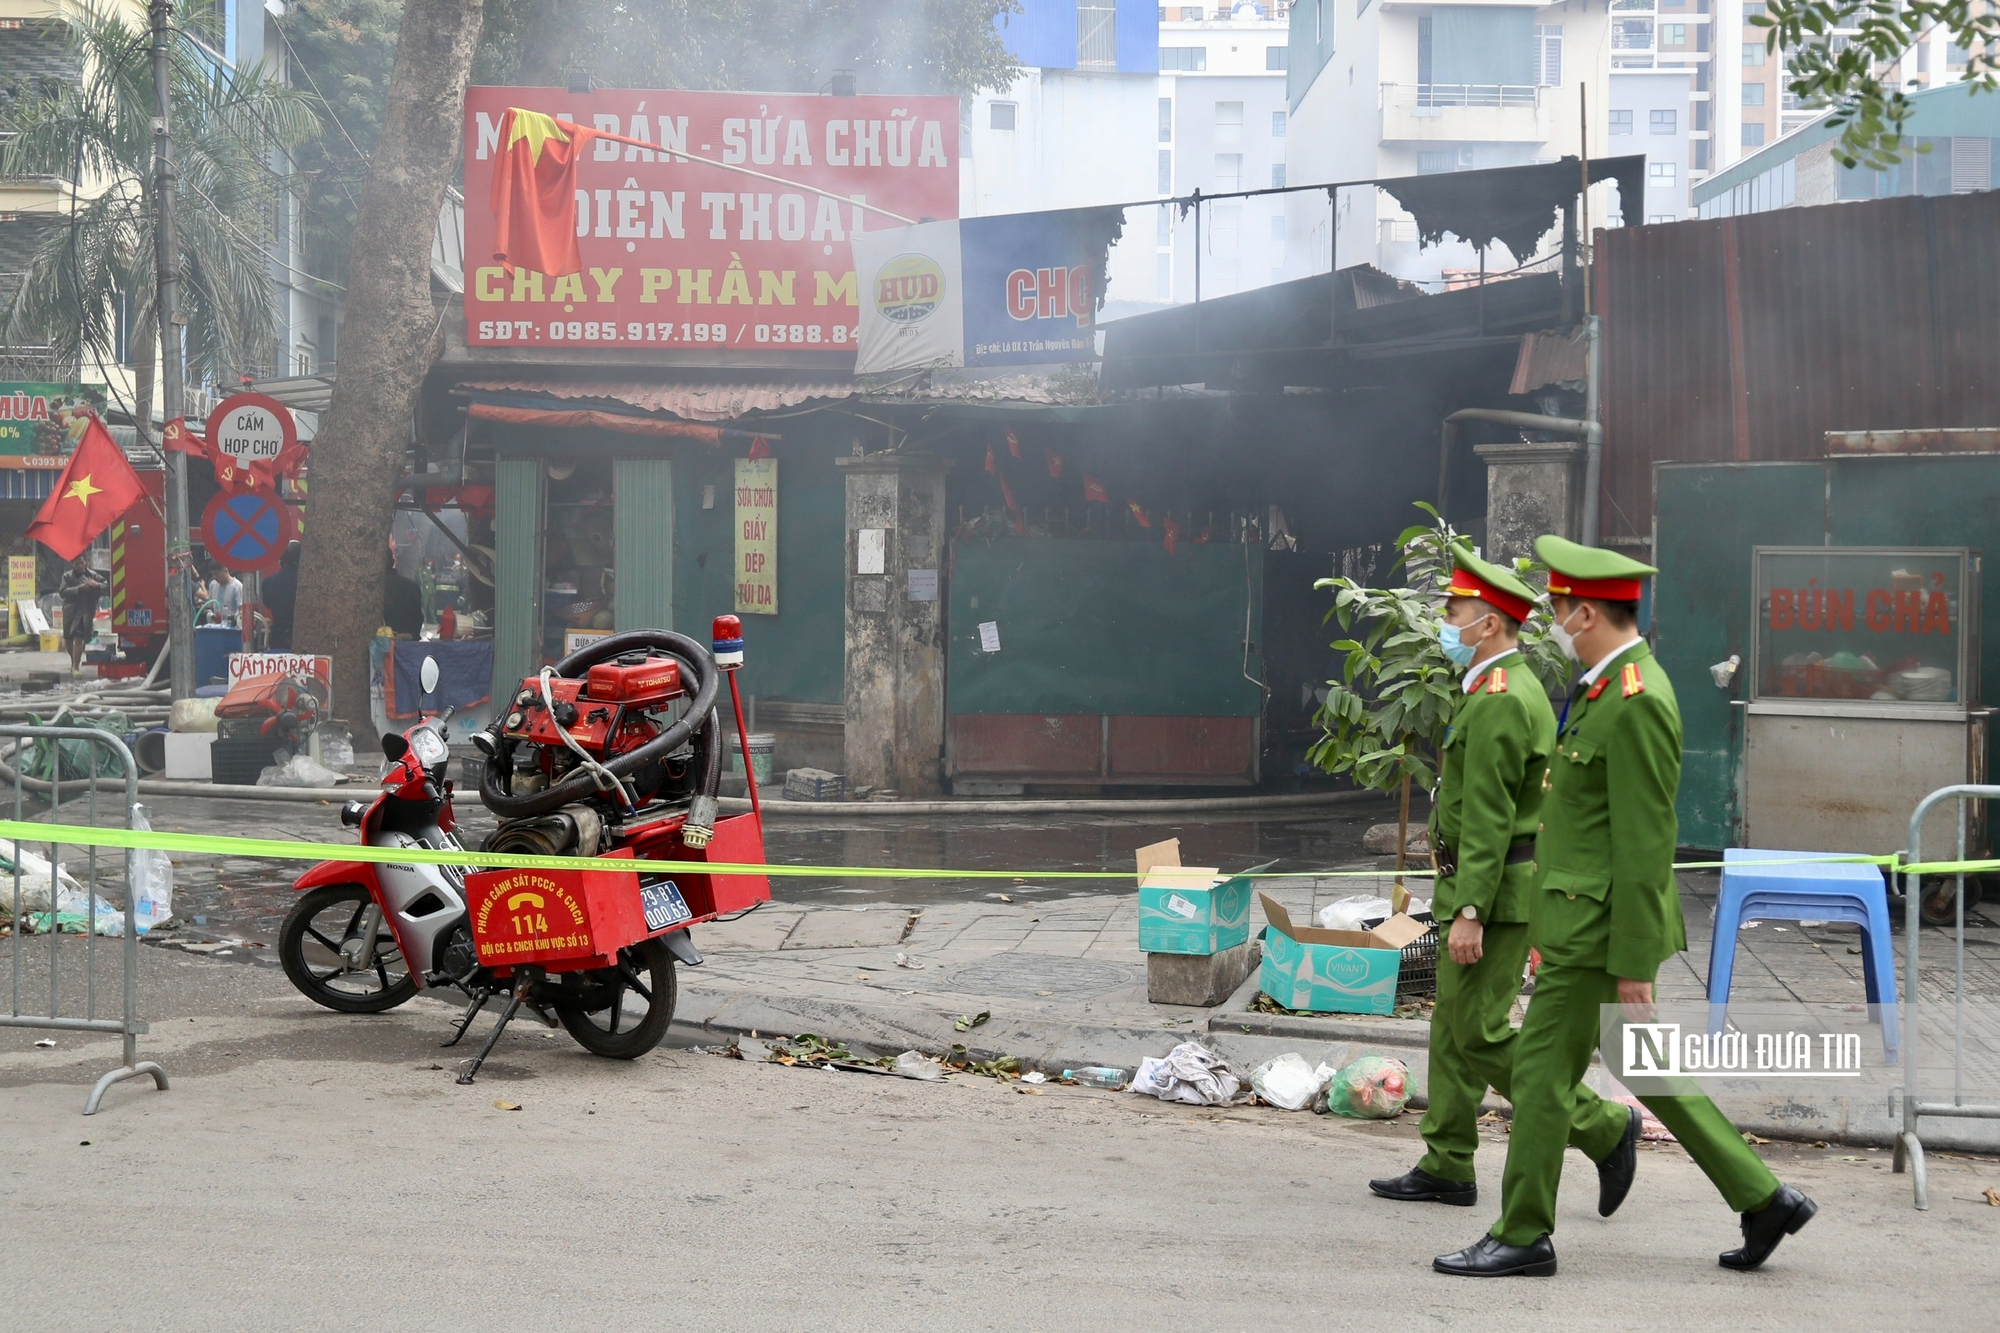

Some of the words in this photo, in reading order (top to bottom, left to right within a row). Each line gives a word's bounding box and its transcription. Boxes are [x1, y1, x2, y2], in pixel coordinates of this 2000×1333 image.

[593, 101, 689, 164] BÁN
[722, 104, 813, 166] SỬA
[825, 108, 948, 168] CHỮA
[701, 192, 867, 256] THOẠI
[475, 266, 624, 313] CHẠY
[639, 251, 797, 306] PHẦN
[879, 273, 939, 303] HUD
[479, 321, 541, 341] SĐT:
[550, 321, 727, 342] 0985.917.199
[734, 323, 746, 344] /
[1023, 341, 1028, 352] 2
[237, 411, 264, 431] CẤM
[224, 438, 249, 456] HỌP
[253, 440, 279, 459] CHỢ
[32, 457, 55, 466] 0393
[745, 549, 765, 573] DÉP
[738, 580, 754, 604] TÚI
[757, 584, 772, 605] DA
[1770, 577, 1854, 632] BÚN
[1864, 571, 1950, 635] CHẢ
[230, 653, 264, 679] CẤM
[645, 675, 671, 687] TOHATSU
[386, 863, 415, 873] HONDA
[478, 898, 493, 934] PHÒNG
[489, 880, 512, 900] CẢNH
[512, 874, 529, 888] SÁT
[531, 876, 556, 892] PCCC
[556, 887, 564, 898] &
[563, 895, 584, 925] CNCH
[646, 900, 688, 926] 000.65
[511, 913, 549, 935] 114
[481, 942, 494, 957] ĐỘI
[494, 943, 505, 954] CC
[506, 943, 513, 953] &
[513, 940, 534, 952] CNCH
[535, 938, 550, 950] KHU
[551, 937, 566, 950] VỰC
[566, 932, 578, 947] SỐ
[578, 935, 589, 946] 13
[1330, 963, 1365, 974] VIVANT
